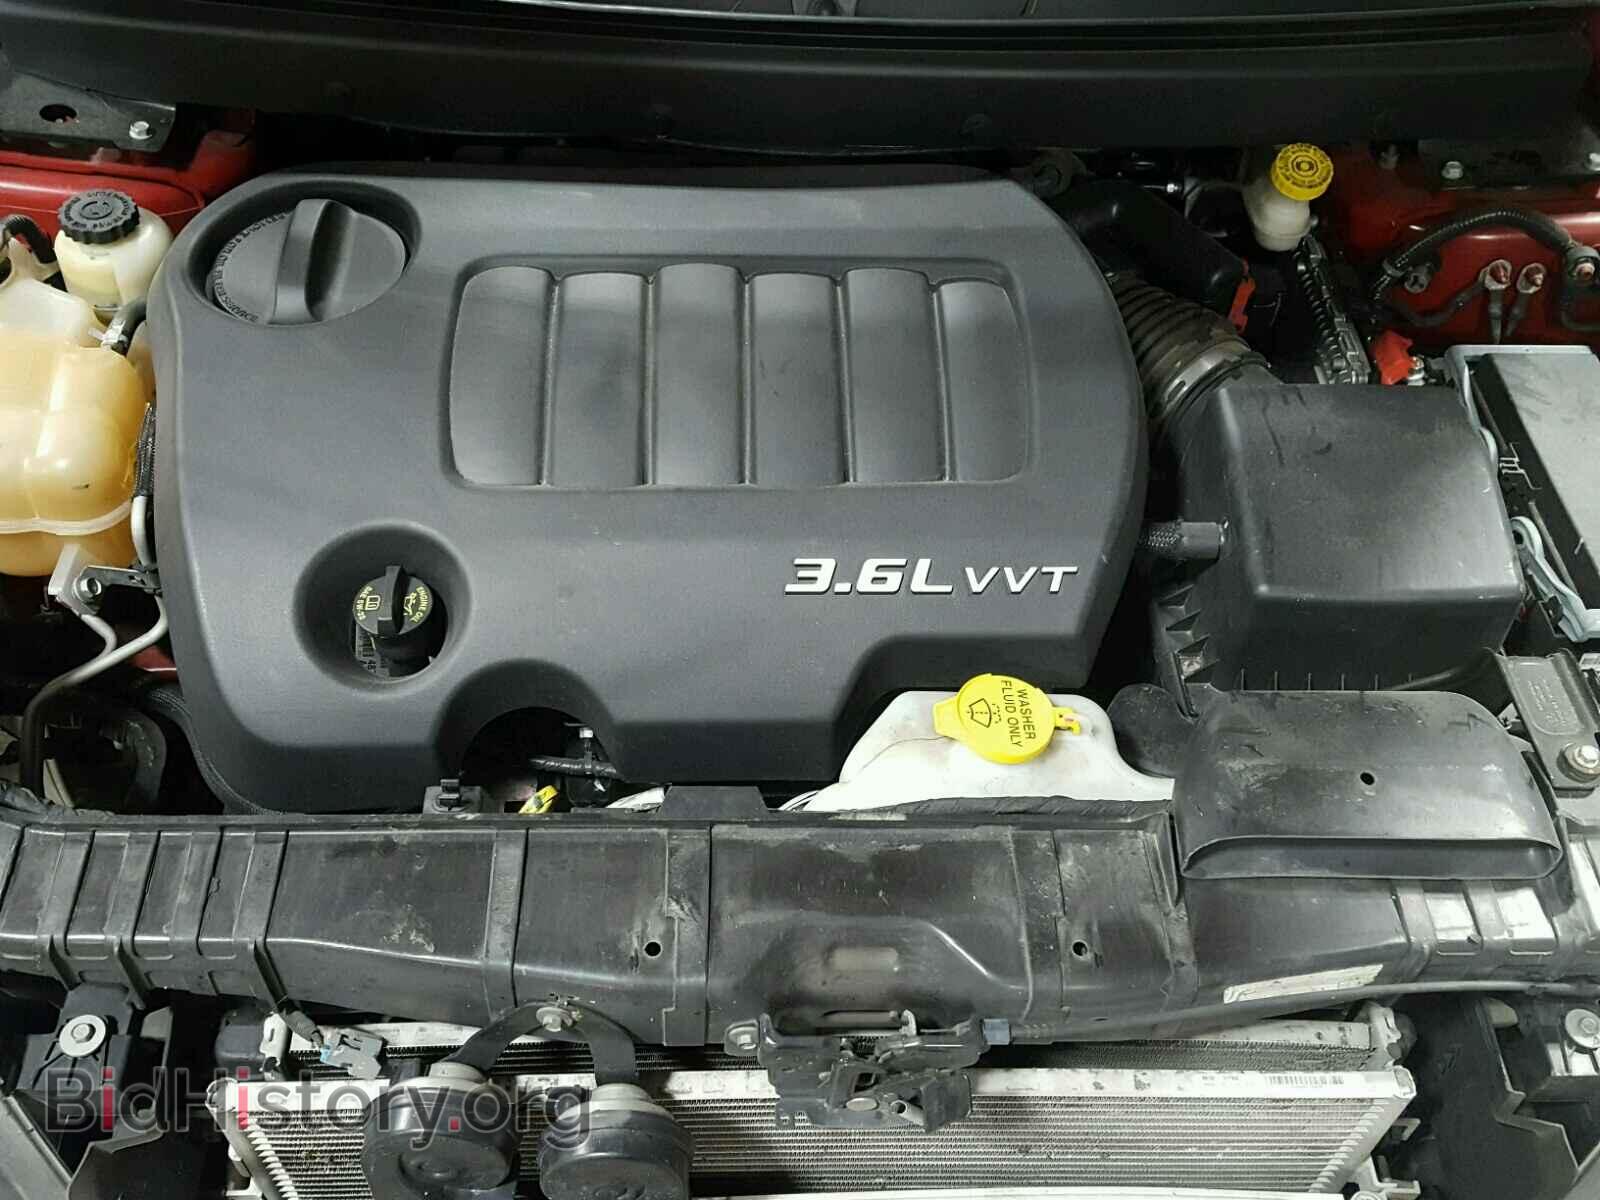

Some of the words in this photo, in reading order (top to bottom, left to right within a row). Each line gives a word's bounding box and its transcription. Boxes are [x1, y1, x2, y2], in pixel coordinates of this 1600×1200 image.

[784, 557, 953, 595] 3.6L
[964, 565, 1079, 595] VVT
[415, 586, 428, 611] ENGINE
[410, 611, 424, 623] OIL
[1001, 679, 1017, 714] FLUID
[1016, 688, 1036, 740] WASHER
[1007, 716, 1023, 748] ONLY
